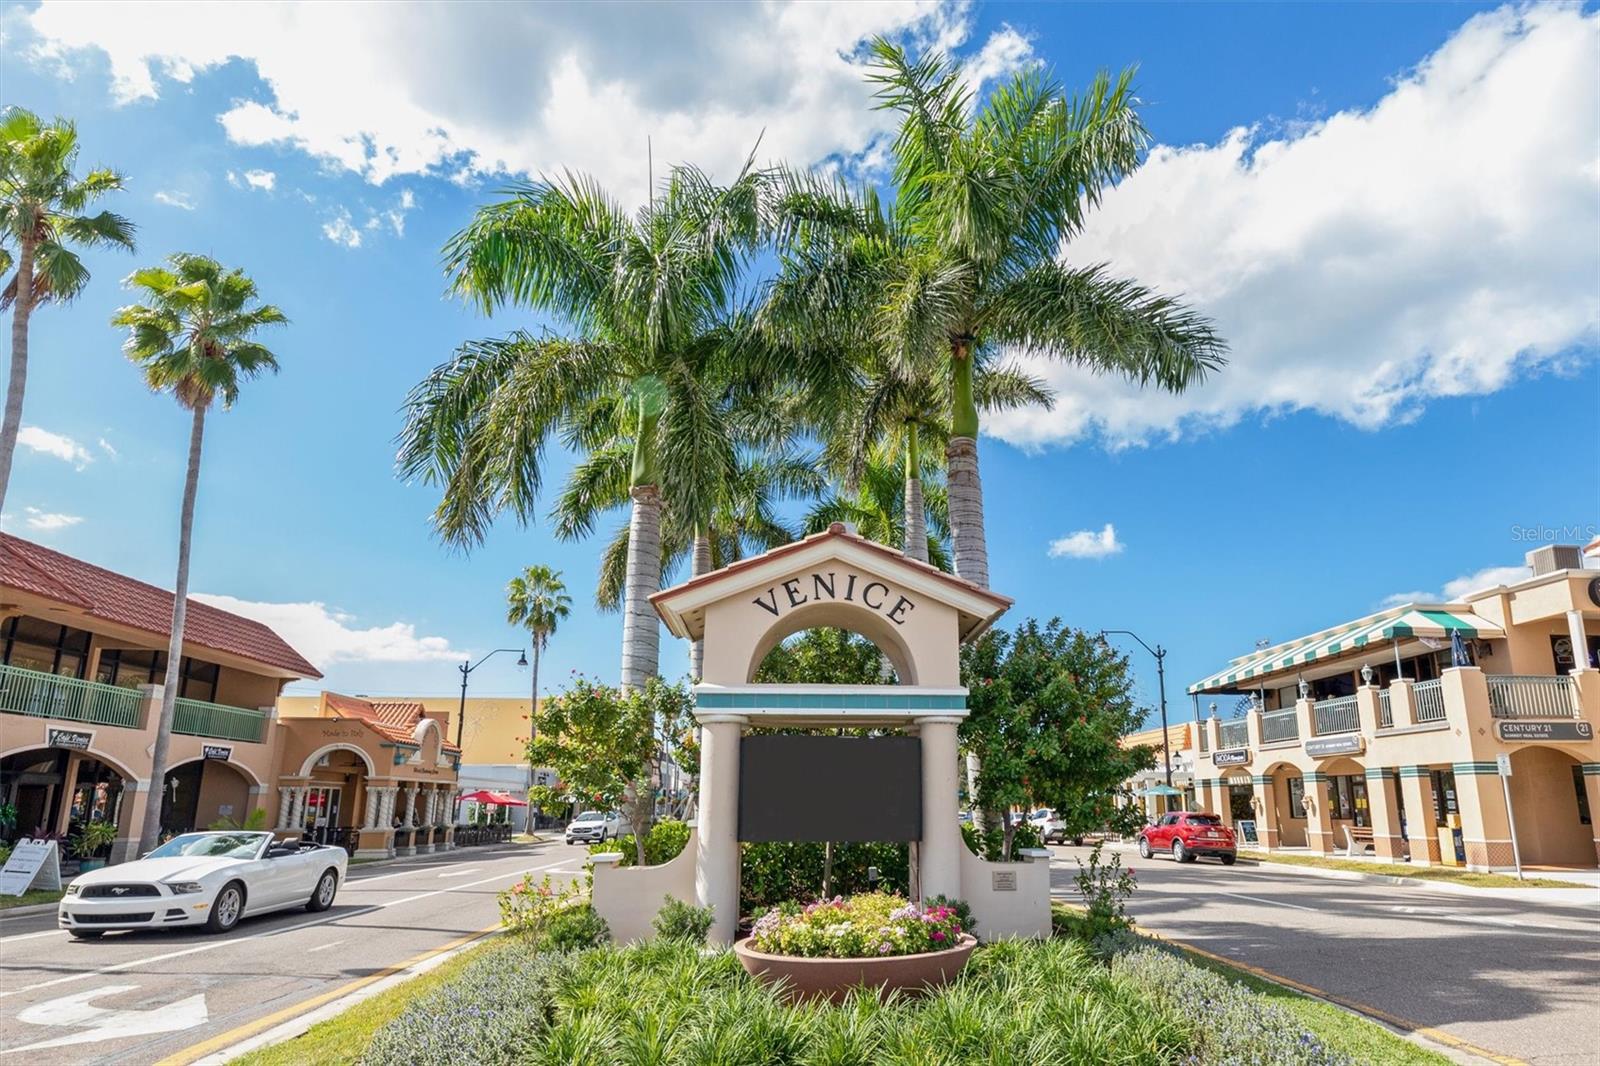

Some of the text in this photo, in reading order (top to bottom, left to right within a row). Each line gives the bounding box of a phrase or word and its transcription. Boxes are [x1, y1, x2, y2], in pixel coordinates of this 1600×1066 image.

[752, 572, 916, 626] VENICE
[1503, 724, 1553, 732] CENTURY 21
[1579, 724, 1589, 732] 21
